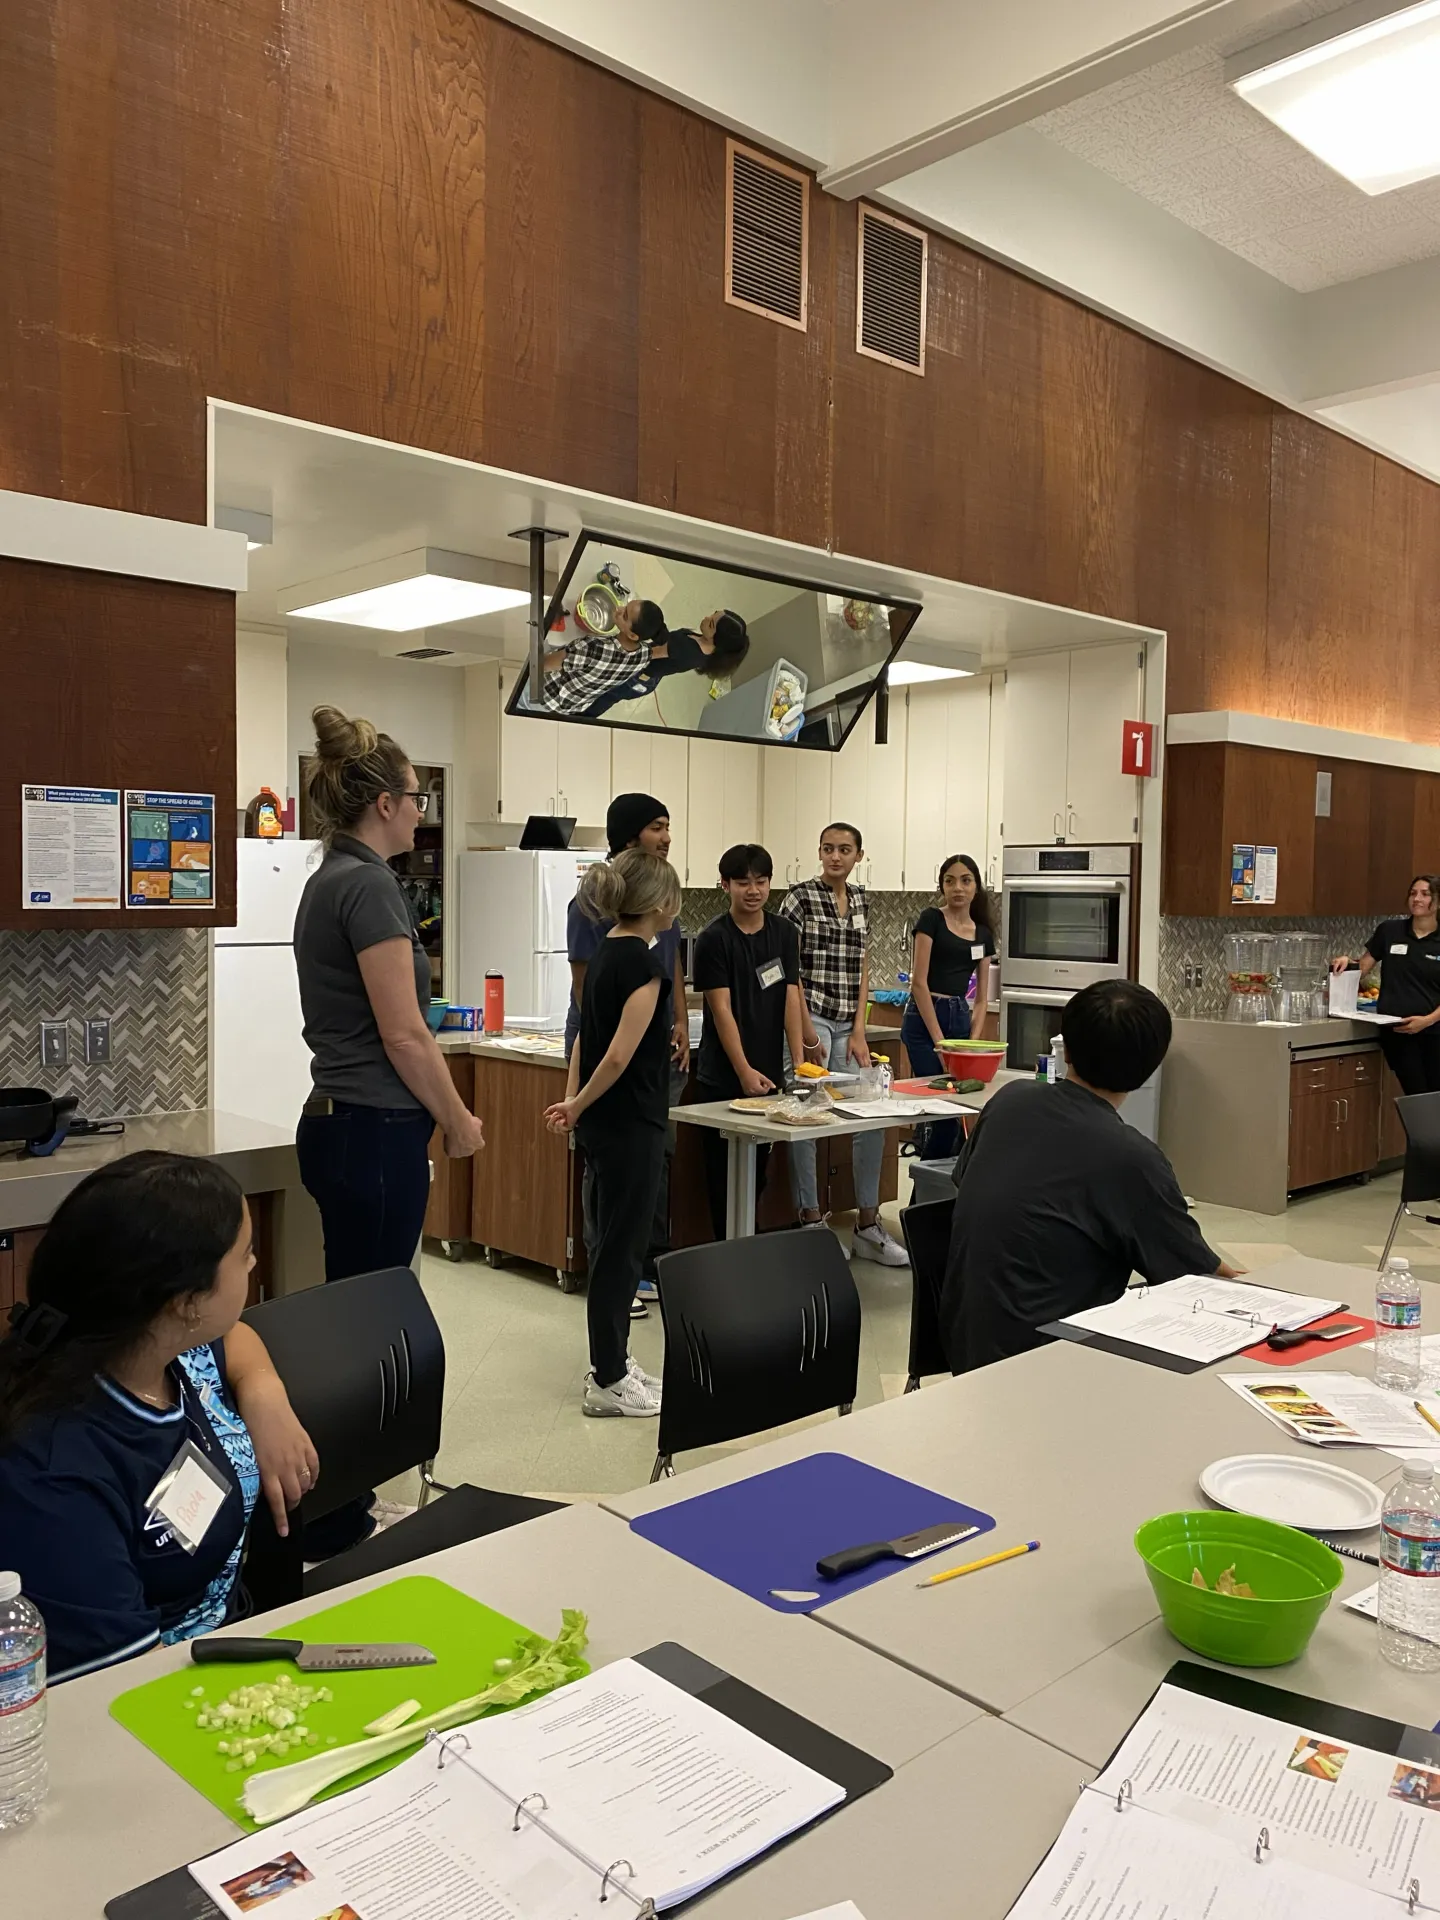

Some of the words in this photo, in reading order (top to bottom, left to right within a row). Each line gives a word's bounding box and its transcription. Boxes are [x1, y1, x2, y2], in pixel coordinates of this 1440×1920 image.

[1335, 1544, 1366, 1560] HEART
[736, 1817, 760, 1835] LESSON
[719, 1833, 737, 1844] PLAN
[700, 1843, 720, 1856] WEEK
[1050, 1886, 1067, 1907] LESSON
[1062, 1872, 1075, 1888] PLAN
[1071, 1855, 1085, 1871] WEEK
